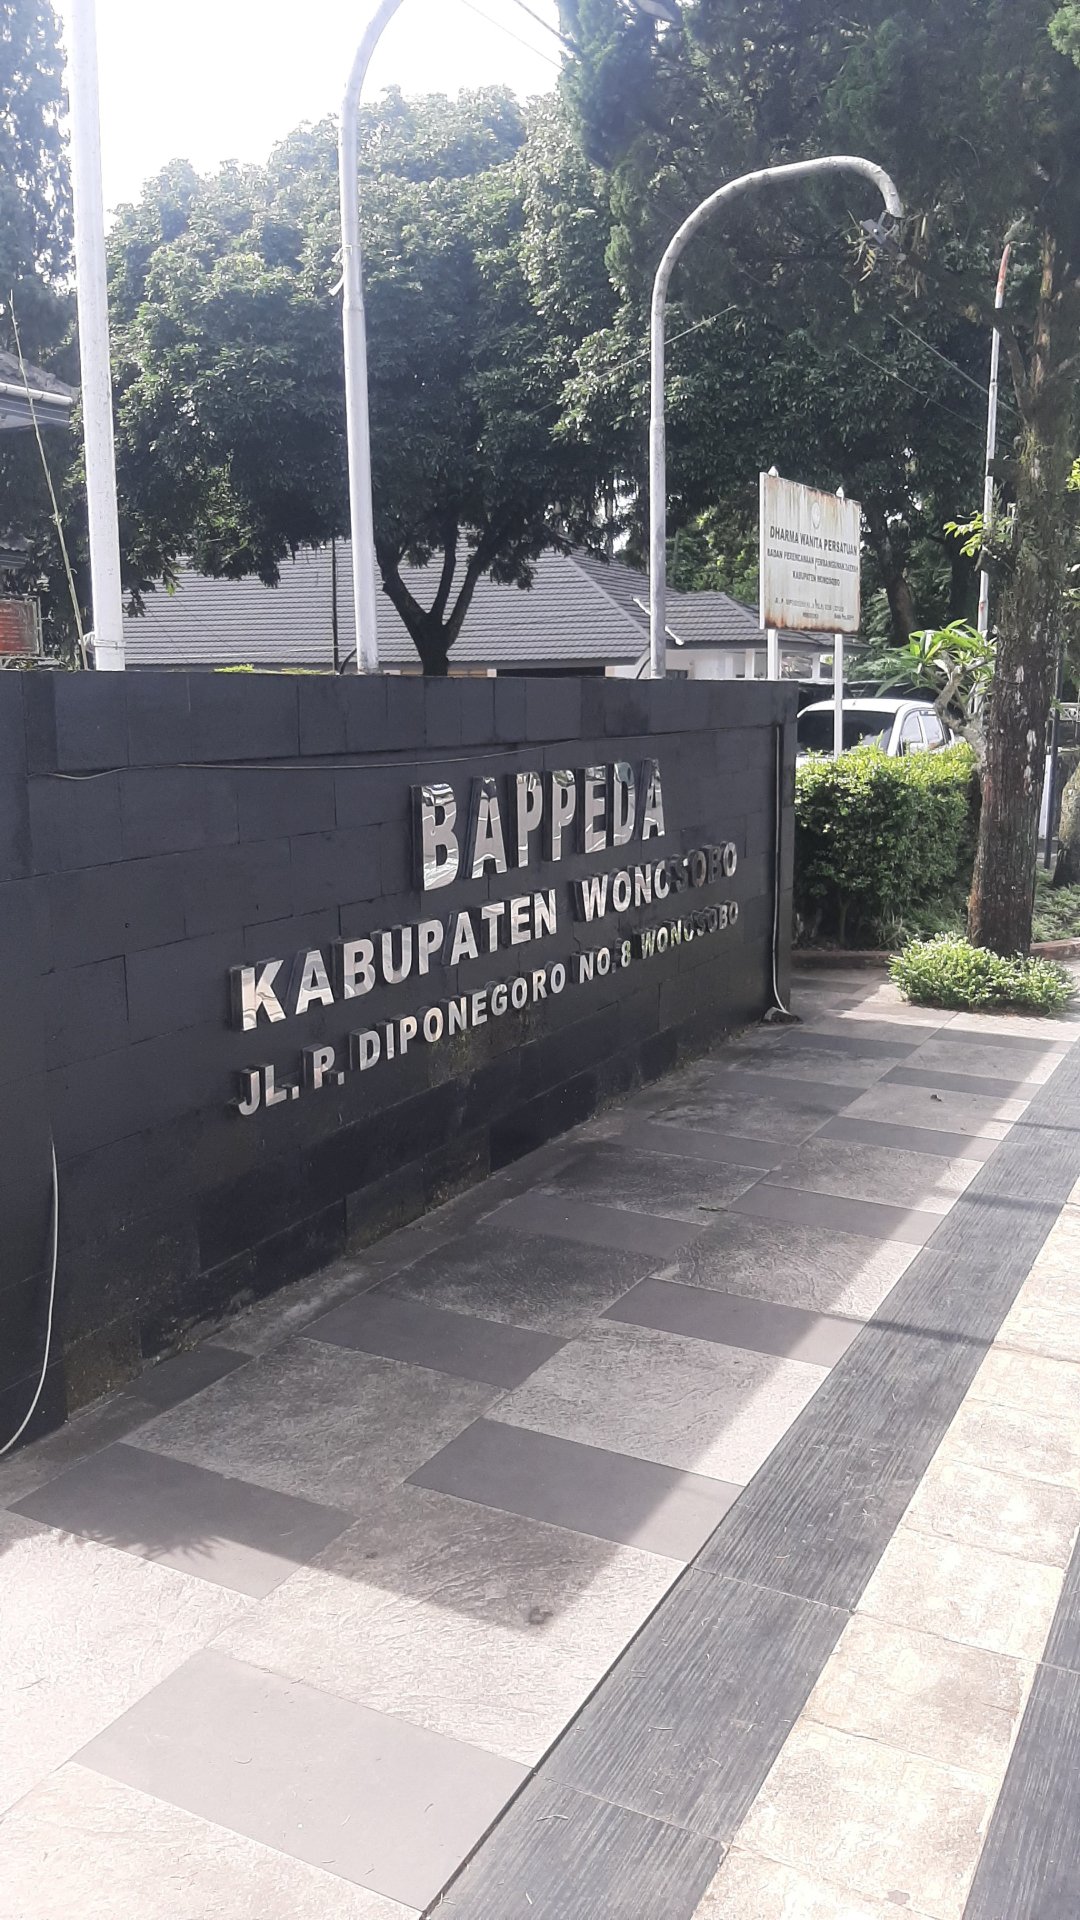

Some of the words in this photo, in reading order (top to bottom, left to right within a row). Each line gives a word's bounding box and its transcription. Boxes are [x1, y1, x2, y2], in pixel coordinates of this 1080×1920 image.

[770, 526, 799, 543] DHARMA
[800, 533, 822, 549] WANITA
[824, 538, 858, 556] PERSATUAN
[420, 758, 666, 891] BAPPEDA
[237, 1064, 300, 1116] JL.
[312, 1046, 345, 1090] P.
[358, 963, 566, 1072] DIPONEGORO
[640, 901, 739, 960] WONOSOBO
[240, 889, 558, 1031] KABUPATEN
[580, 841, 738, 922] WONOSOBO
